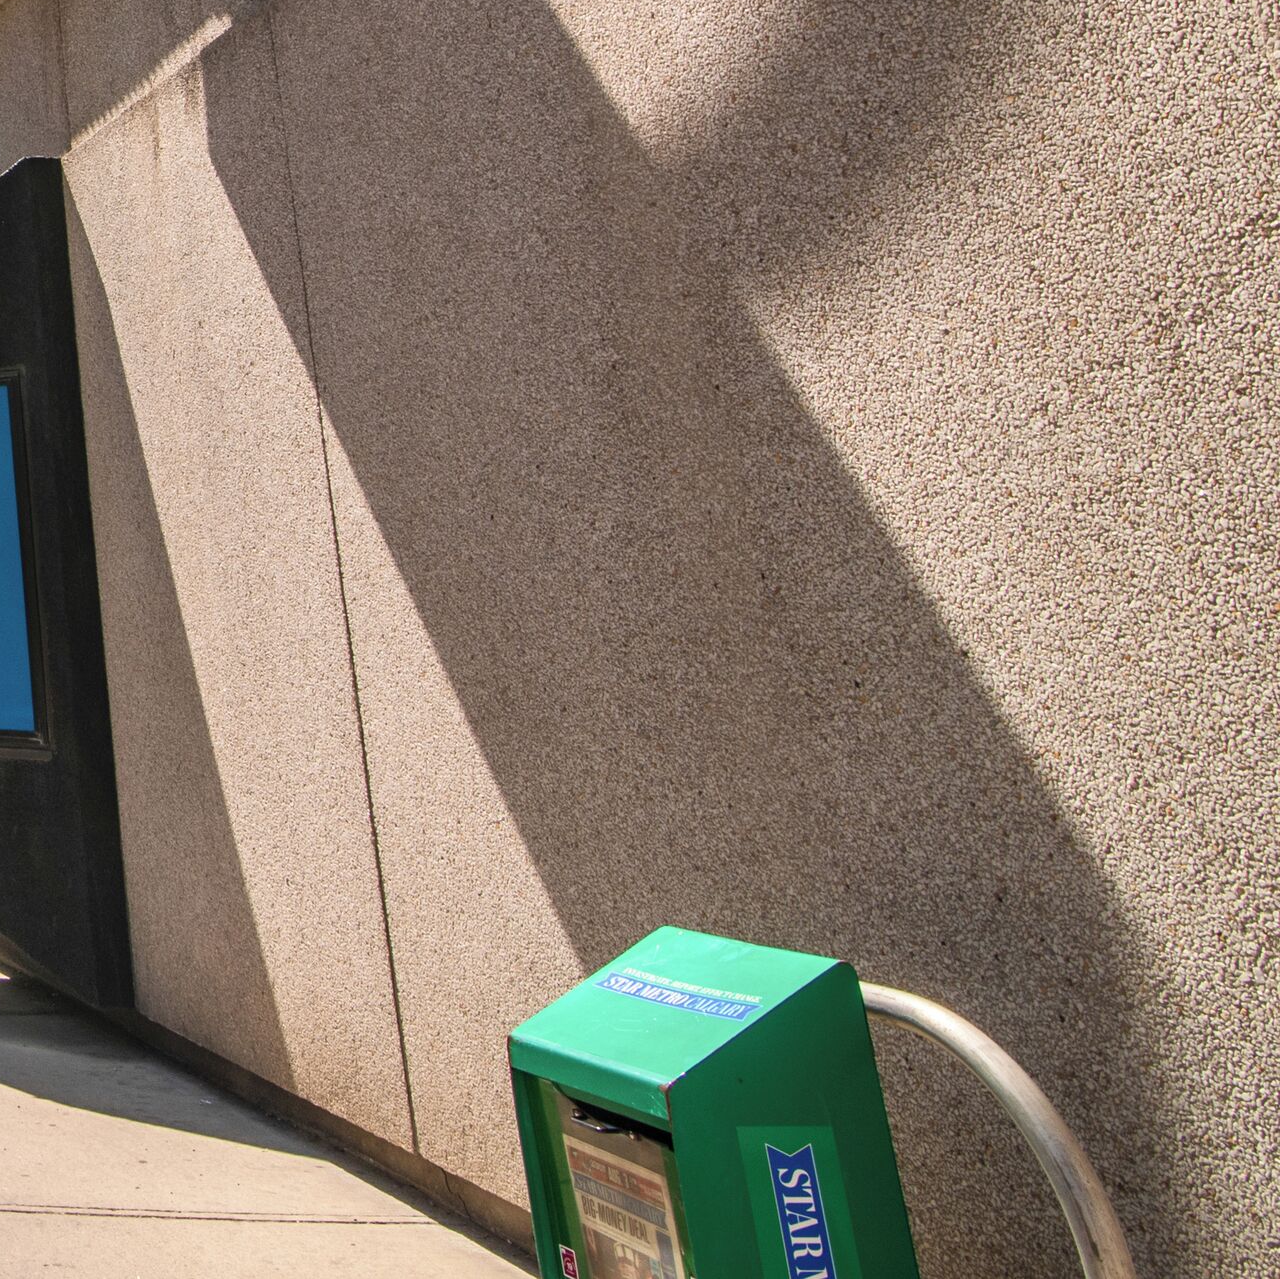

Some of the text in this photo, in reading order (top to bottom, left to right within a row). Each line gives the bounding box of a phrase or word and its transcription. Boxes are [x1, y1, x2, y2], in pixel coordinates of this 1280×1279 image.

[604, 975, 749, 1018] STAR METRO CALGARY
[777, 1168, 824, 1260] STAR
